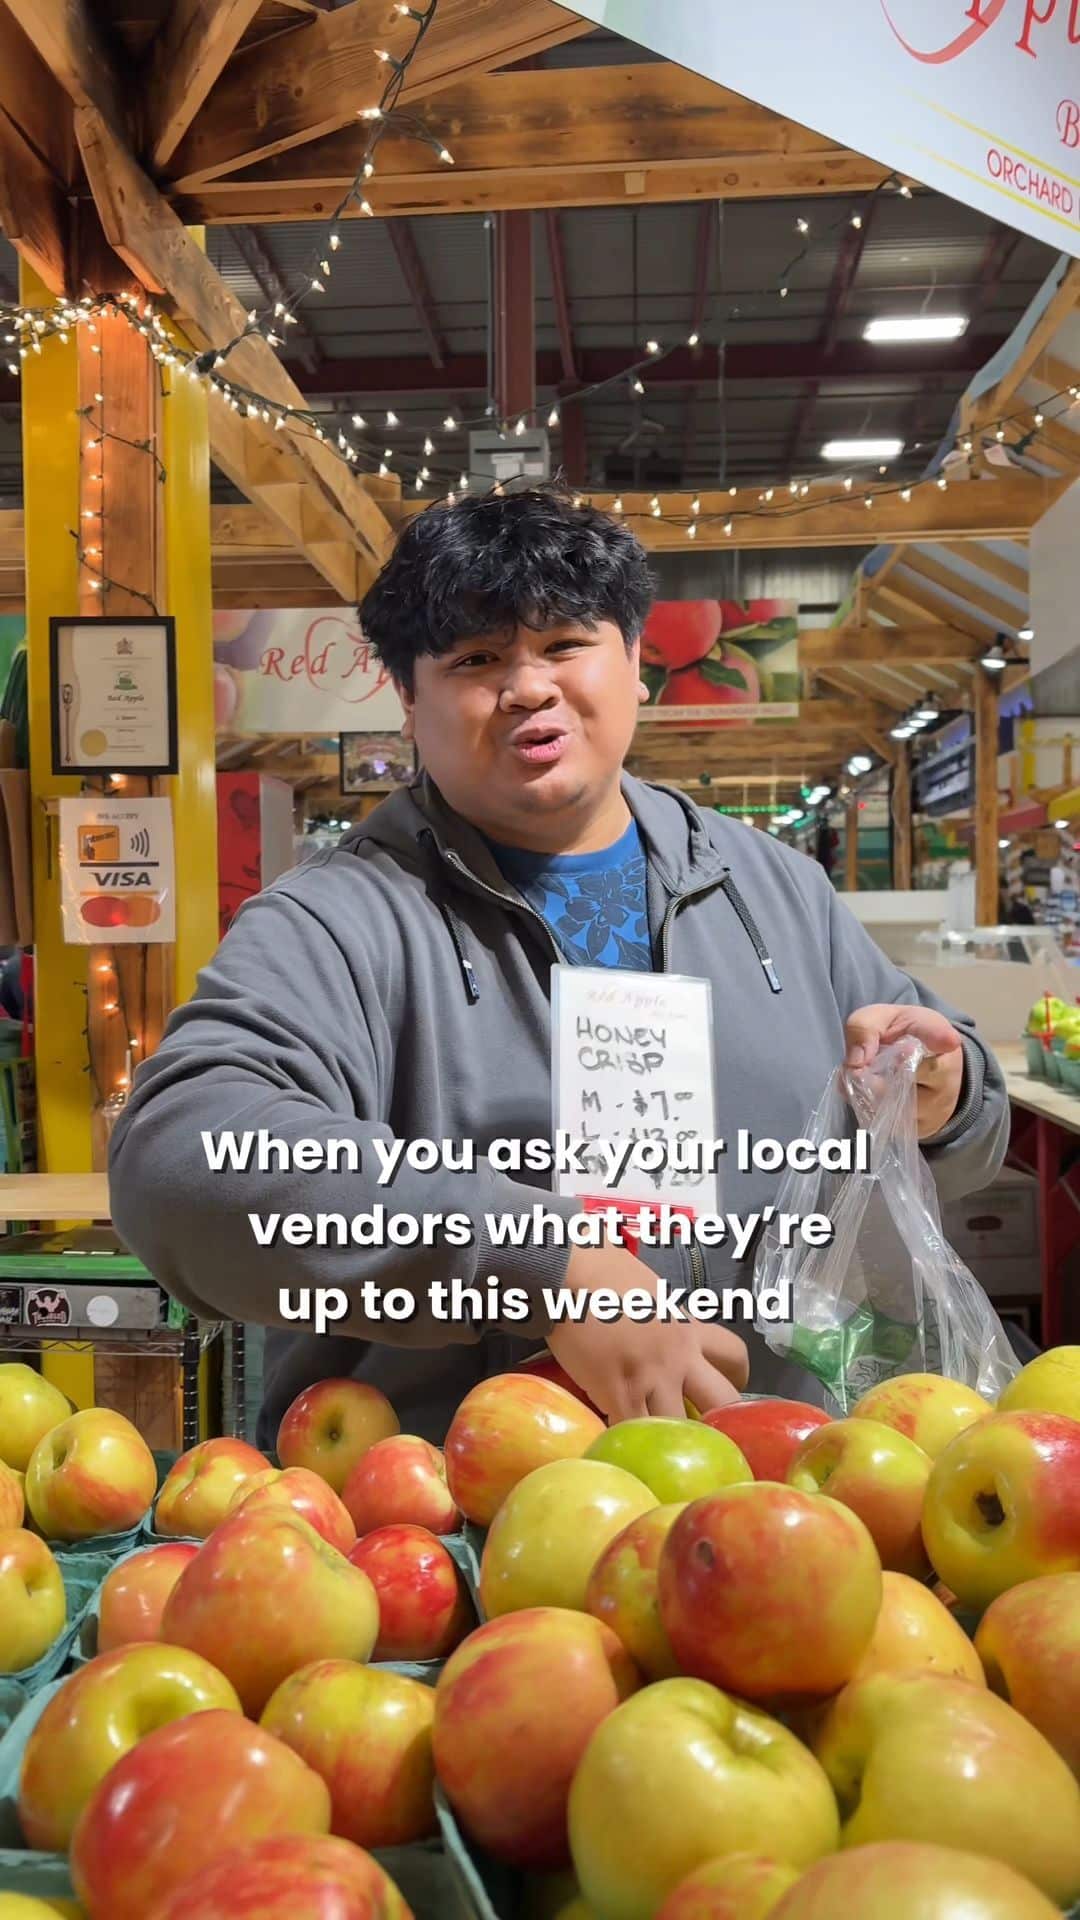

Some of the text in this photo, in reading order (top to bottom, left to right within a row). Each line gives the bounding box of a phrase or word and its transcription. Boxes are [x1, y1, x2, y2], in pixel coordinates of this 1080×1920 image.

[986, 148, 1073, 213] ORCHARD
[261, 642, 336, 682] Red
[90, 872, 151, 886] VISA
[576, 1015, 667, 1049] HONEY
[581, 1089, 602, 1113] M
[581, 1120, 601, 1142] L
